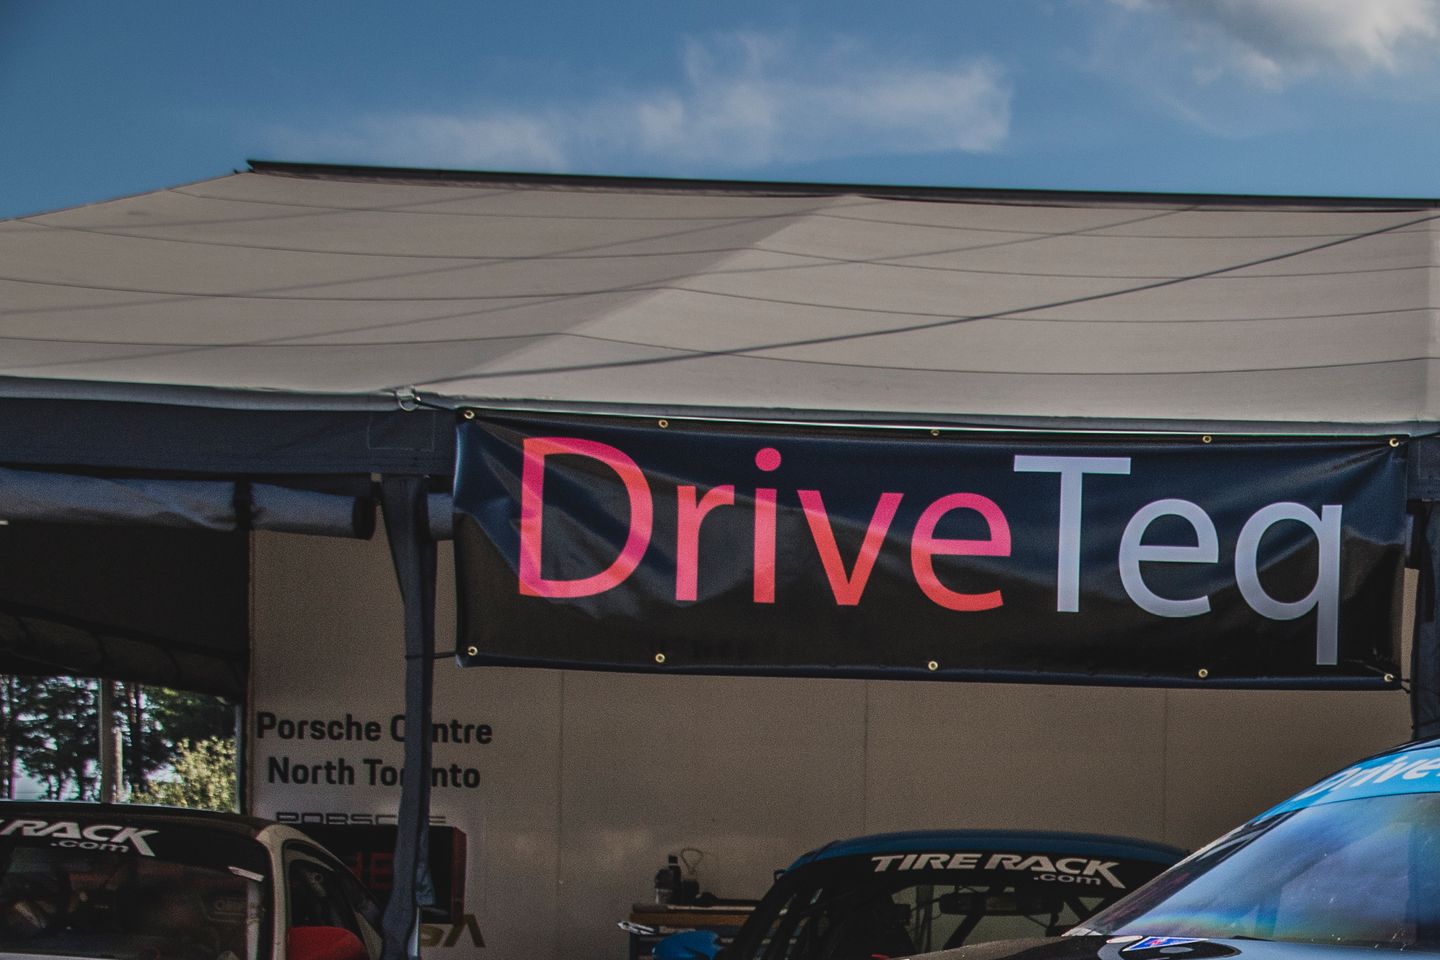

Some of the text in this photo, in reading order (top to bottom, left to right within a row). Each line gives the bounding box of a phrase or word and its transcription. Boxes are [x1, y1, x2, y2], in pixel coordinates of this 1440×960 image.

[519, 436, 1343, 666] DriveTeq
[257, 711, 493, 744] Porsche Cntre
[268, 756, 481, 788] North Tonto
[0, 819, 159, 857] RACK
[871, 853, 1126, 889] TIRE RACK
[1033, 874, 1102, 886] .com
